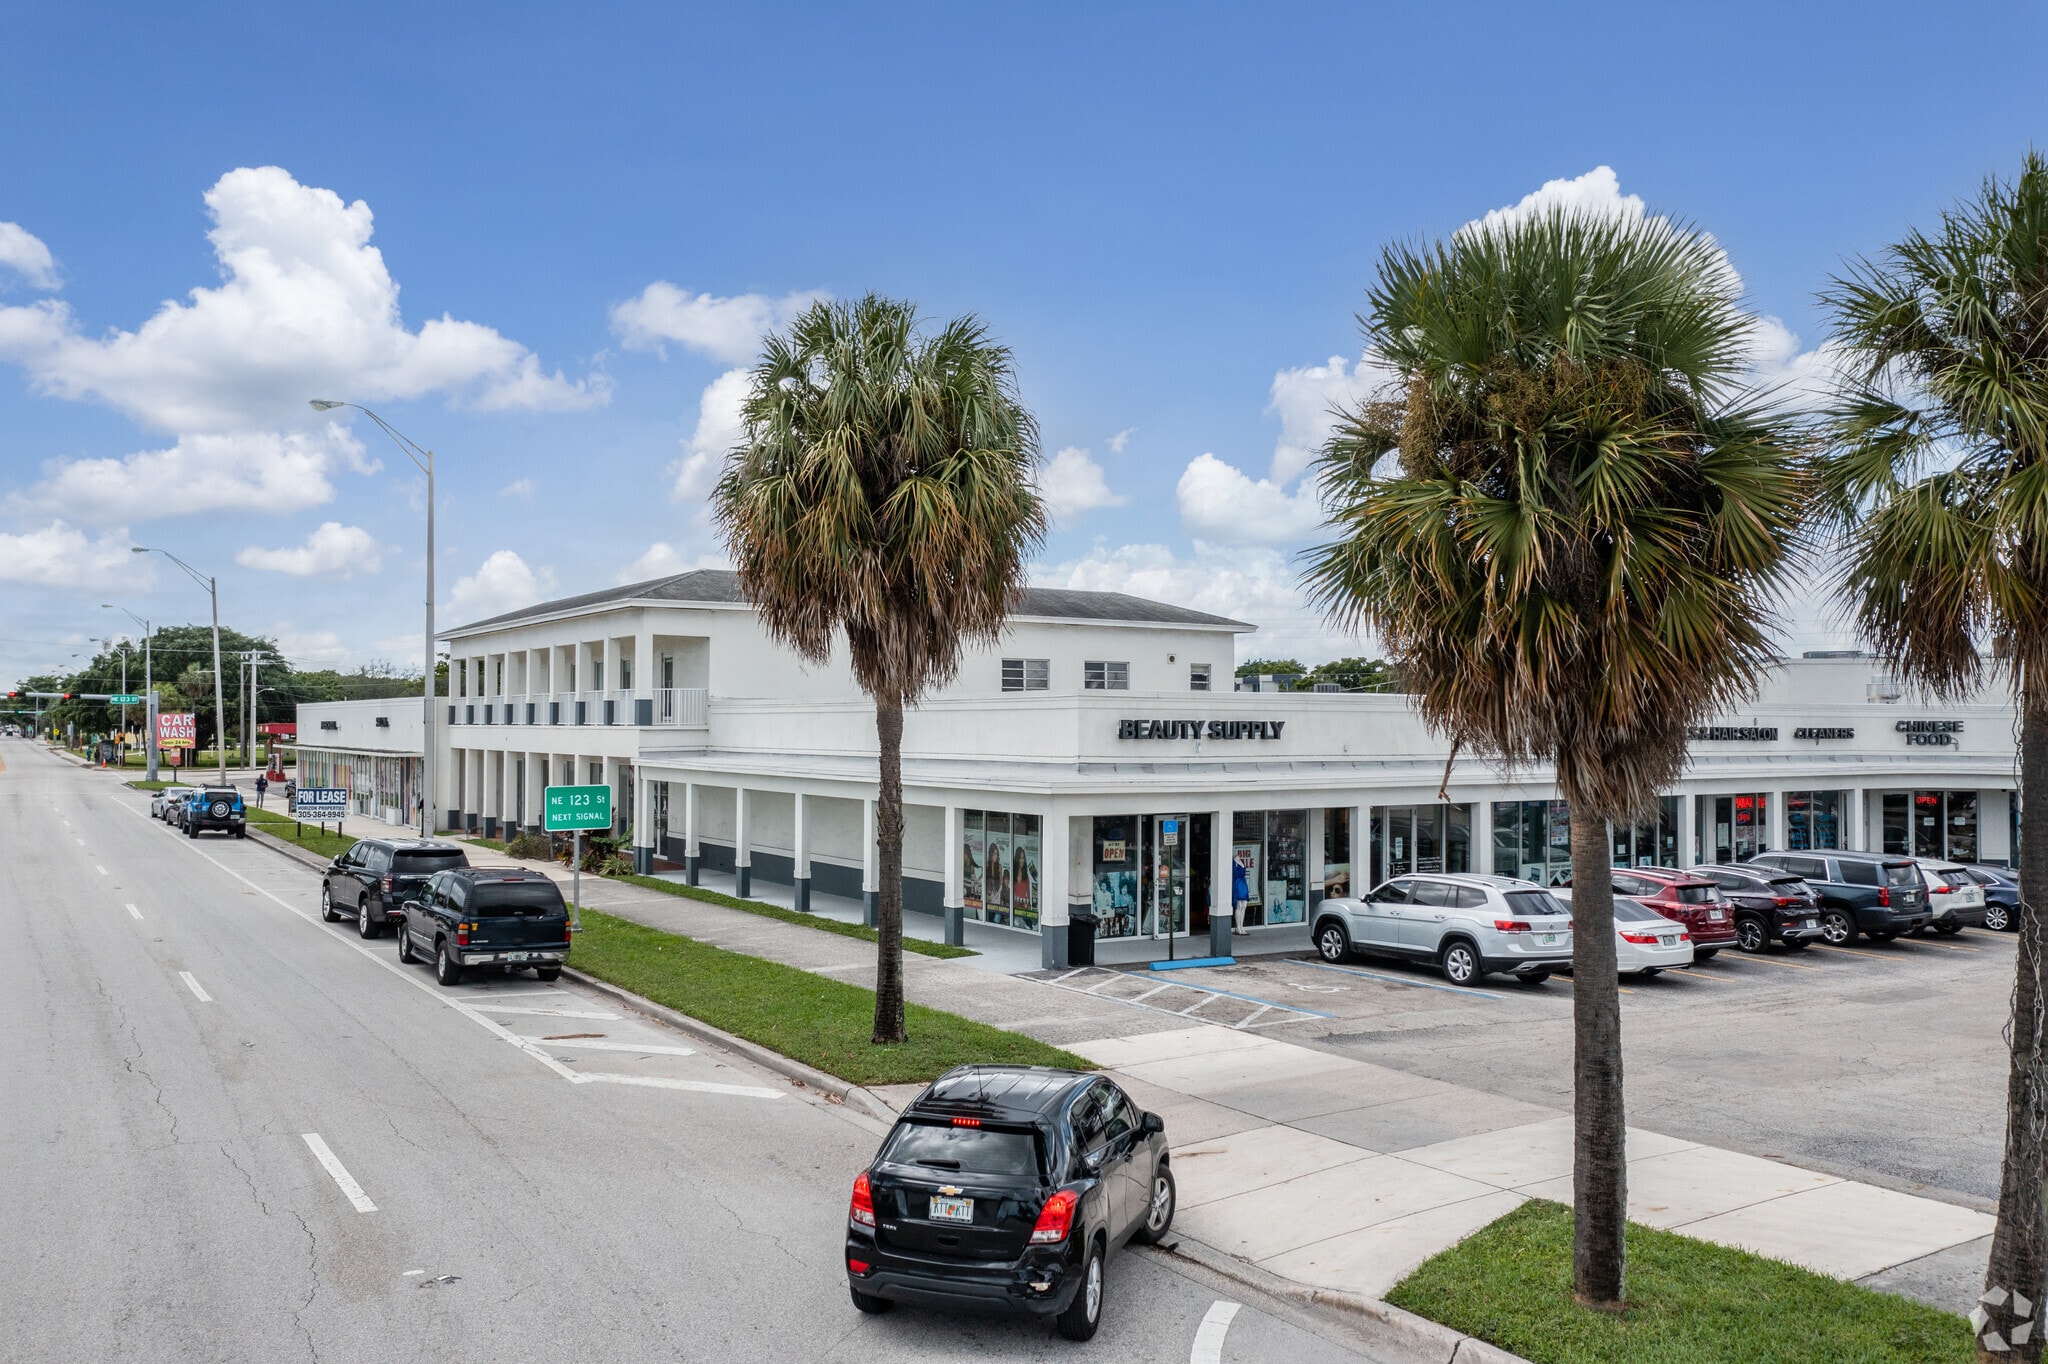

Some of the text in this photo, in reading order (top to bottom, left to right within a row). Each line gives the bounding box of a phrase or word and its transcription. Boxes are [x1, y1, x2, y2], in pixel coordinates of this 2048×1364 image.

[161, 714, 192, 726] CAR
[160, 727, 195, 738] WASH
[1118, 719, 1286, 740] BEAUTY SUPPLY
[1895, 720, 1965, 733] CHINESE
[1711, 727, 1740, 740] HAIR
[1741, 727, 1779, 741] SALON
[1793, 727, 1855, 740] CLEANERS
[1906, 733, 1952, 746] FOOD
[298, 790, 346, 803] FOR LEASE
[551, 794, 605, 806] NE 123 St
[1916, 796, 1937, 804] OPEN
[297, 810, 346, 818] 305-364-9945
[552, 812, 605, 822] NEXT SIGNAL
[1104, 847, 1125, 859] OPEN
[1237, 849, 1251, 858] BIG
